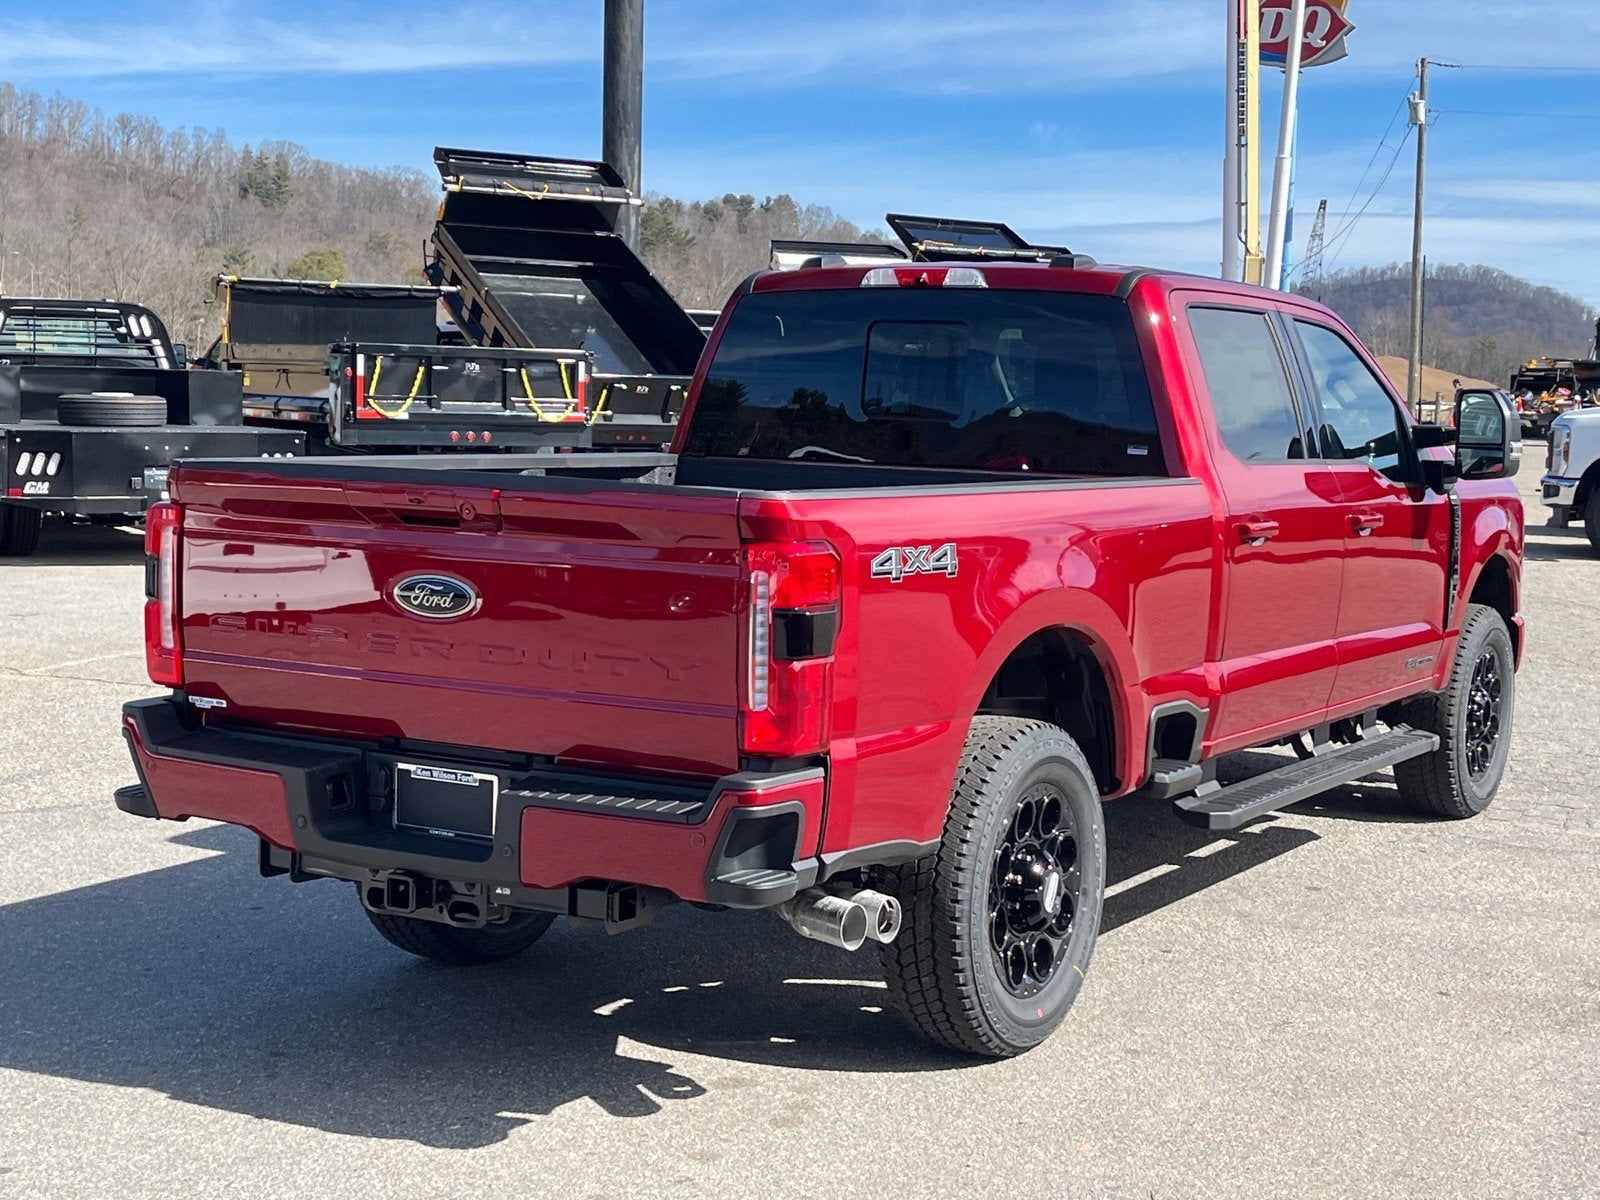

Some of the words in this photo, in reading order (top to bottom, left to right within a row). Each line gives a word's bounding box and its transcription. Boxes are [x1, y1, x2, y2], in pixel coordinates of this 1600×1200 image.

[1260, 6, 1332, 48] DQ
[410, 583, 454, 608] Ford
[209, 615, 454, 661] SUPER
[478, 643, 699, 683] DUTY
[416, 767, 431, 776] Ken
[431, 770, 456, 780] Wilson
[457, 773, 474, 782] Ford
